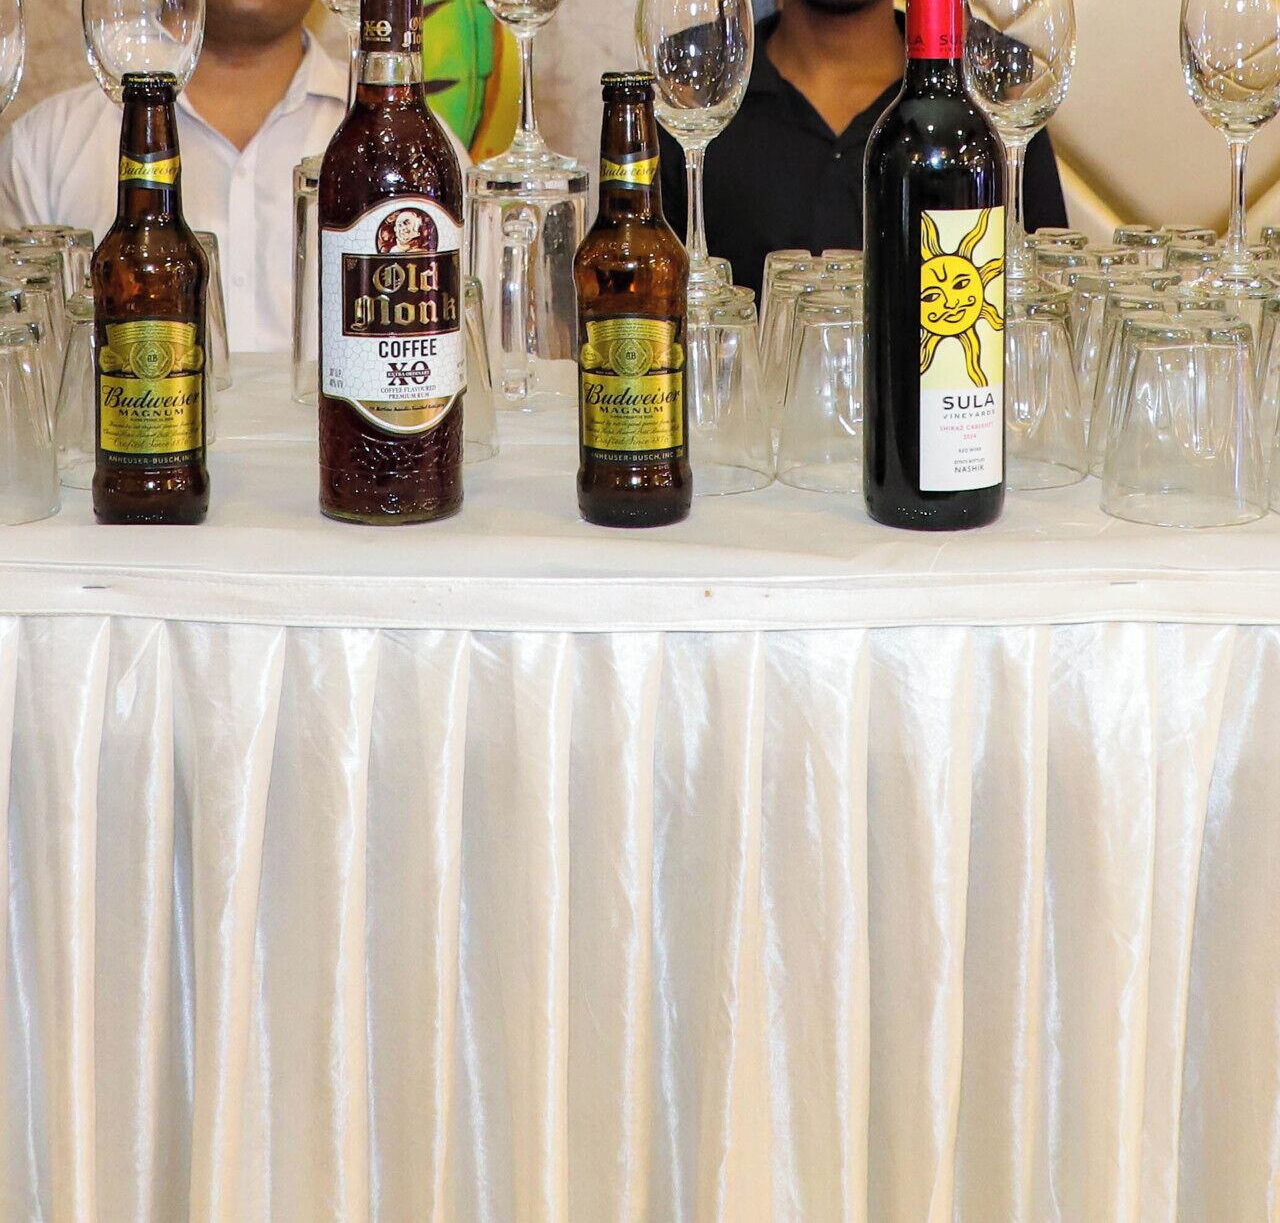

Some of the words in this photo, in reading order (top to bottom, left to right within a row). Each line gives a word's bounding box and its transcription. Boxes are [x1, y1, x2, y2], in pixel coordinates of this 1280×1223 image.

[372, 261, 440, 294] Old
[350, 292, 457, 332] Monk
[379, 338, 437, 358] COFFEE
[387, 360, 431, 387] XO
[102, 385, 200, 409] Budweiser
[584, 382, 680, 405] Budweiser
[942, 393, 995, 410] SULA
[119, 408, 184, 417] MAGNUM
[599, 405, 664, 415] MAGNUM
[954, 464, 985, 474] NASHIK
